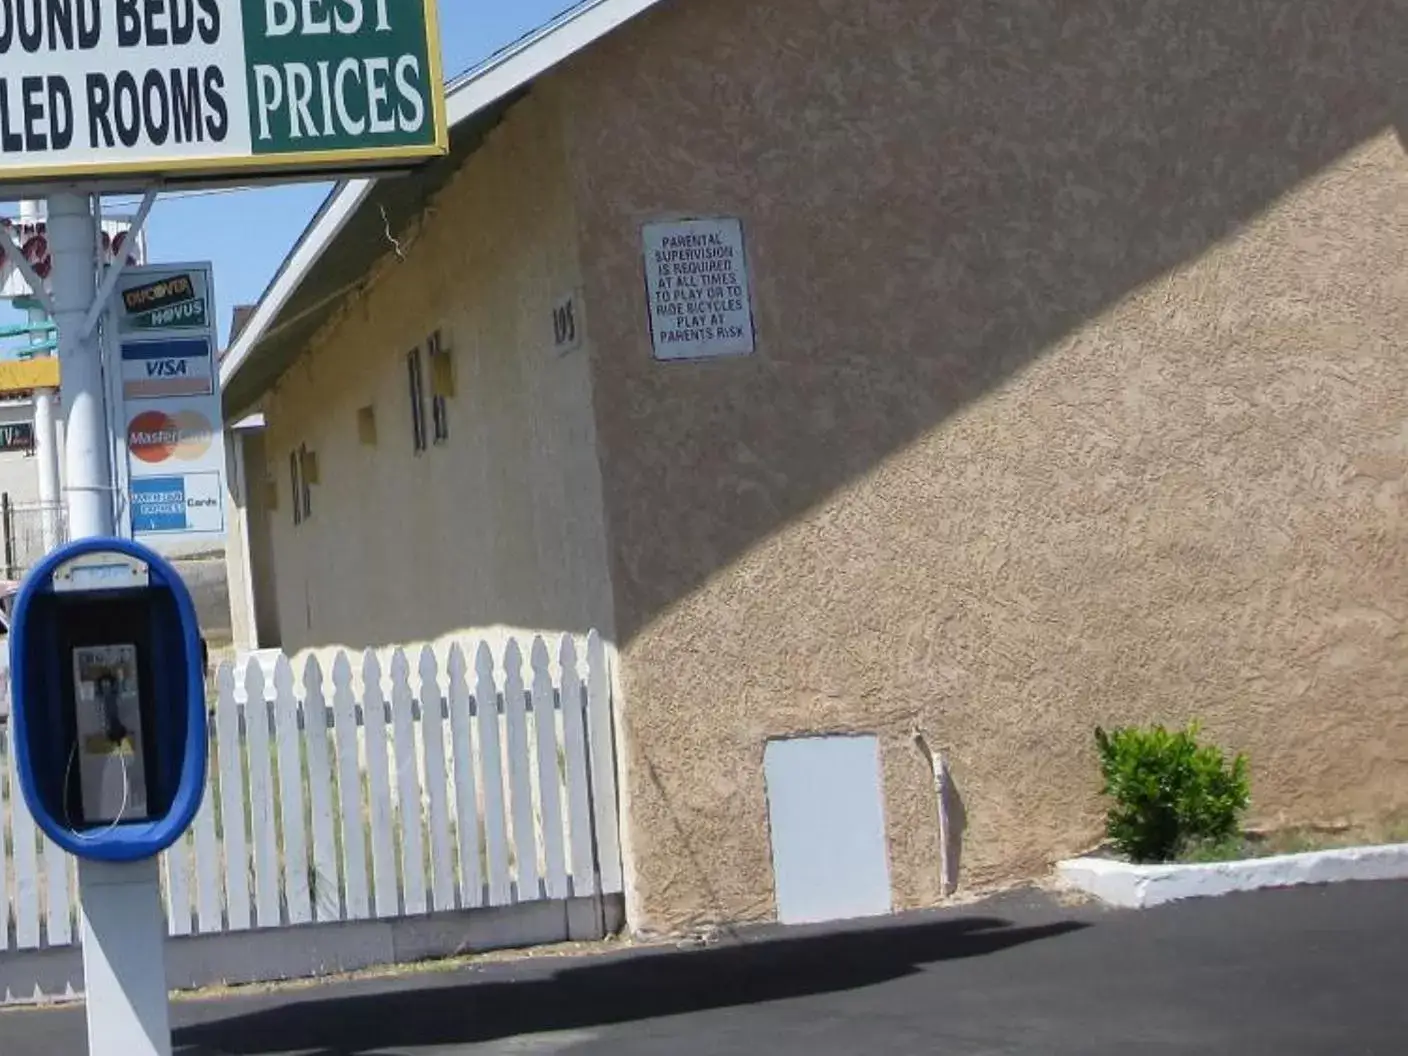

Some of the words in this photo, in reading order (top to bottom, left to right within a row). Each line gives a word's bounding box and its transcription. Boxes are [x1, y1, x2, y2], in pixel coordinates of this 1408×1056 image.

[254, 54, 424, 141] PRICES
[87, 64, 229, 150] ROOMS
[662, 233, 722, 248] PARENTAL
[655, 246, 734, 262] SUPERVISION
[658, 263, 670, 275] IS
[673, 260, 732, 275] REQUIRED
[658, 276, 672, 289] AT
[676, 275, 697, 287] ALL
[701, 273, 738, 285] TIMES
[655, 290, 671, 302] TO
[673, 288, 704, 301] PLAY
[707, 287, 723, 299] OR
[726, 285, 742, 298] TO
[151, 300, 203, 325] NOVUS
[656, 302, 685, 315] RIDE
[687, 299, 743, 314] BICYCLES
[675, 314, 706, 328] PLAY
[710, 313, 725, 326] AT
[660, 327, 713, 343] PARENTS
[716, 325, 744, 339] RISK
[146, 359, 188, 376] VISA
[187, 497, 217, 508] Cards
